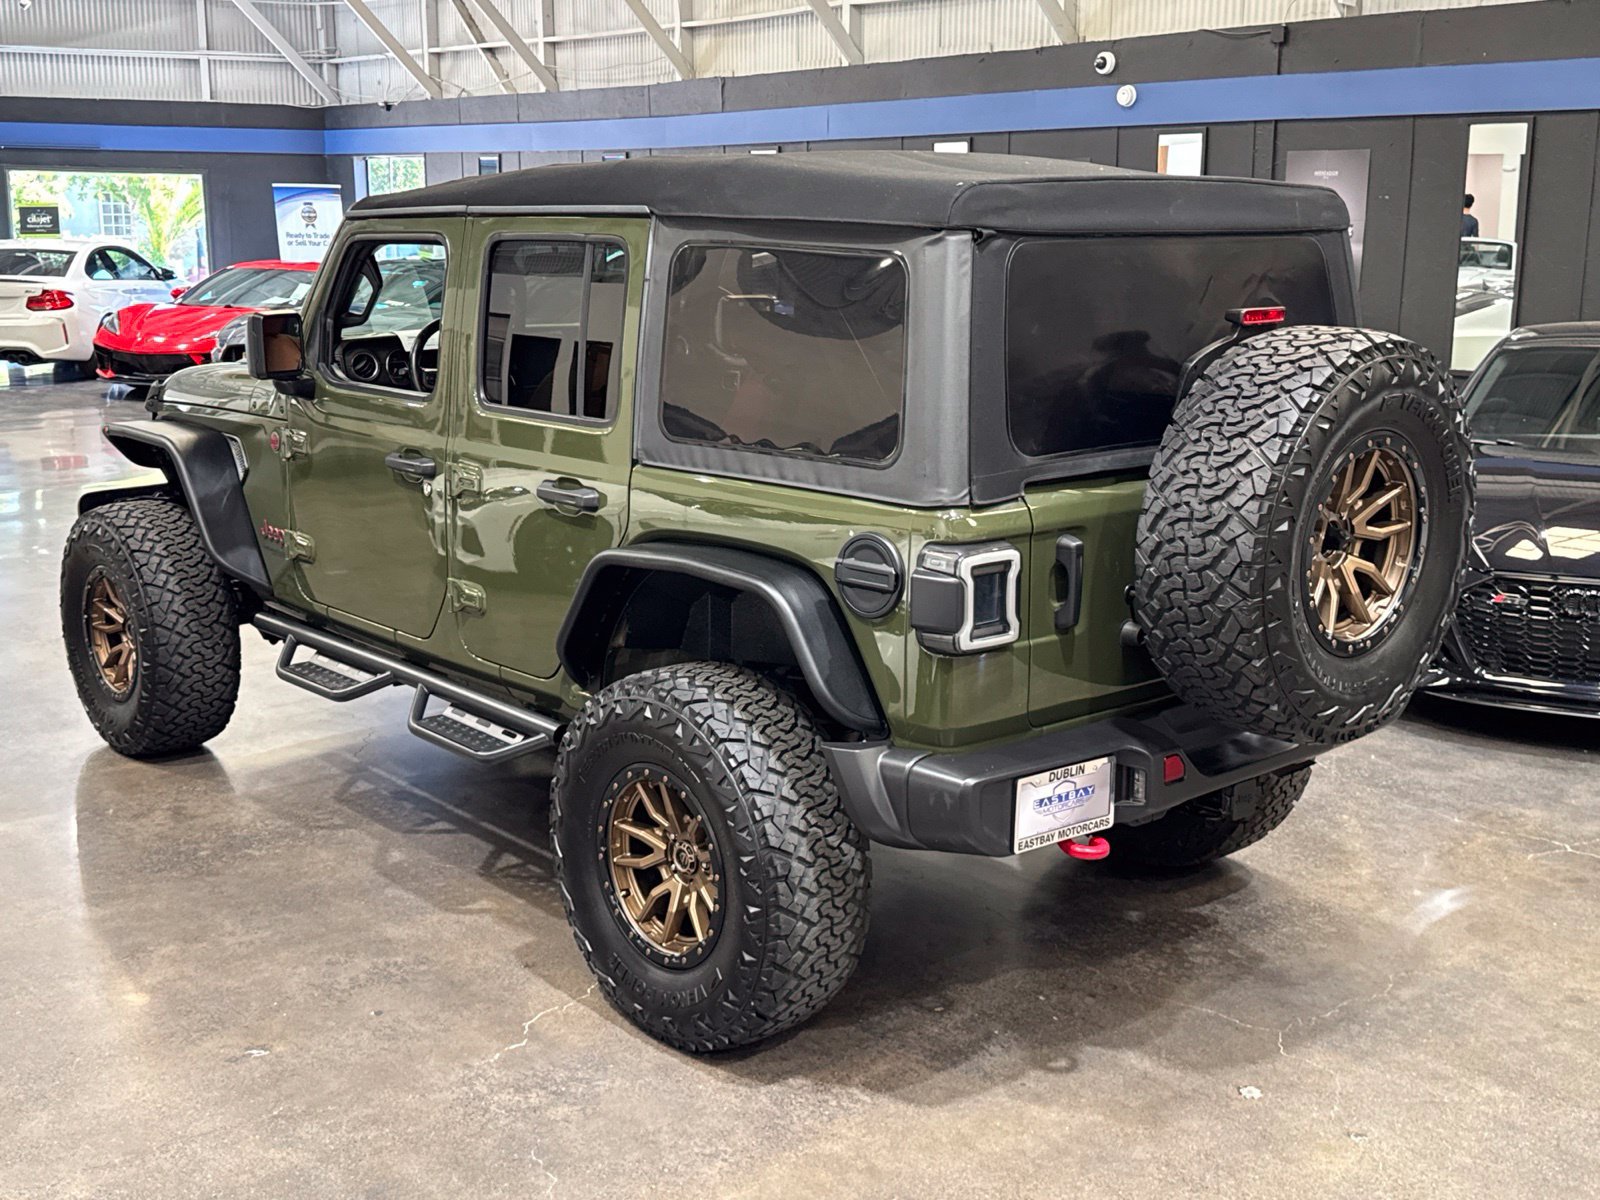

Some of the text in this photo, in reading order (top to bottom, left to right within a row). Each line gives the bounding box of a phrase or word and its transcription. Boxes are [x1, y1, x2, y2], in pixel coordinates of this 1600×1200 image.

[285, 231, 304, 239] Ready
[260, 518, 286, 547] Jeep
[1049, 764, 1085, 782] DUBLIN
[1034, 785, 1094, 809] EASTBAY
[1018, 818, 1110, 851] EASTBAY MOTORCARS
